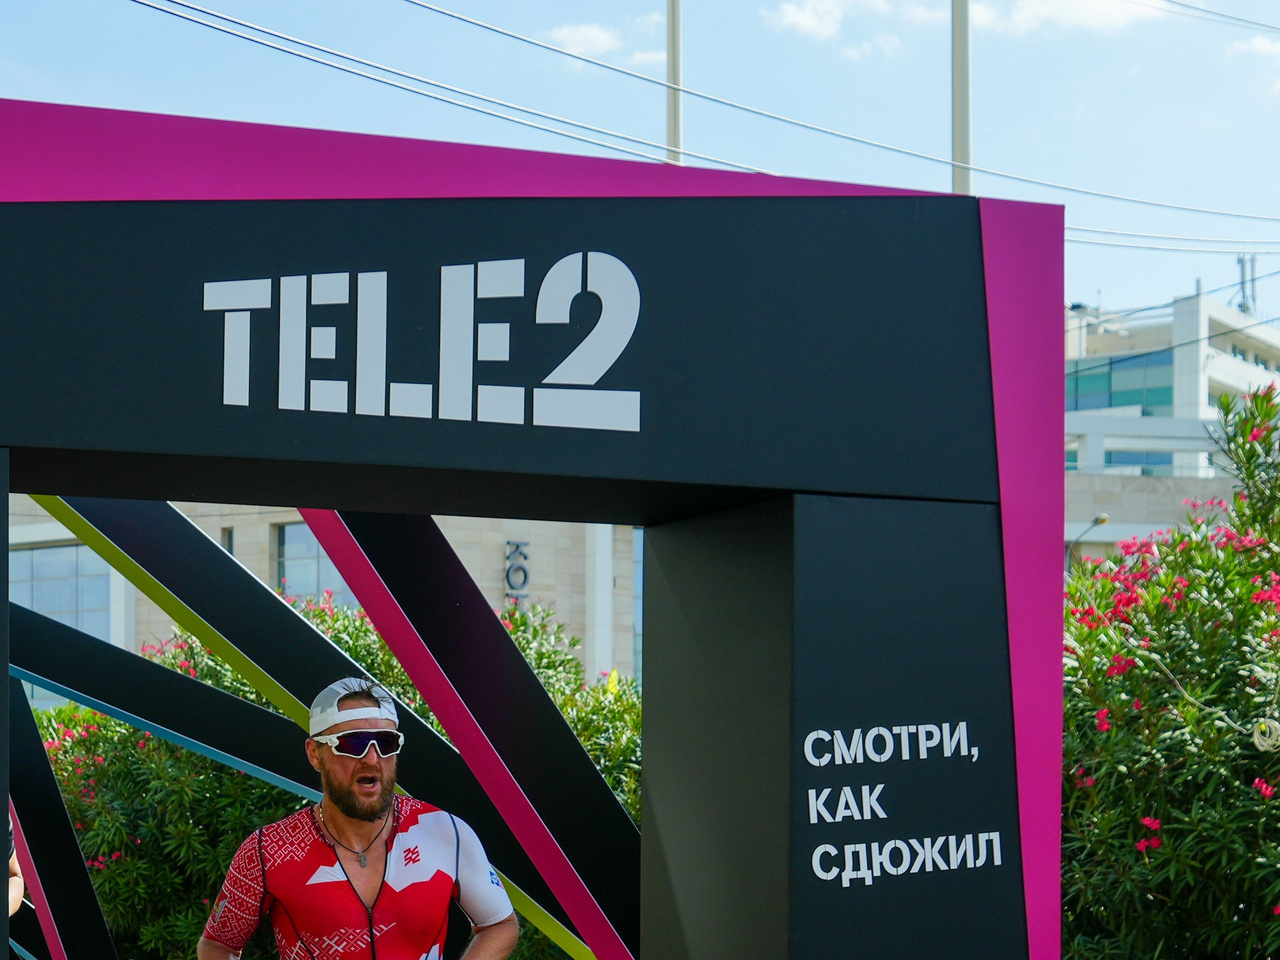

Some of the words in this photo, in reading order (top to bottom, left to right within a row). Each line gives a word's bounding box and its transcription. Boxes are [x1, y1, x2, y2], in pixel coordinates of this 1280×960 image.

[203, 250, 641, 432] TELE2
[803, 721, 979, 767] СМОТРИ,
[807, 783, 888, 824] КАК
[811, 831, 1002, 888] СДЮЖИЛ
